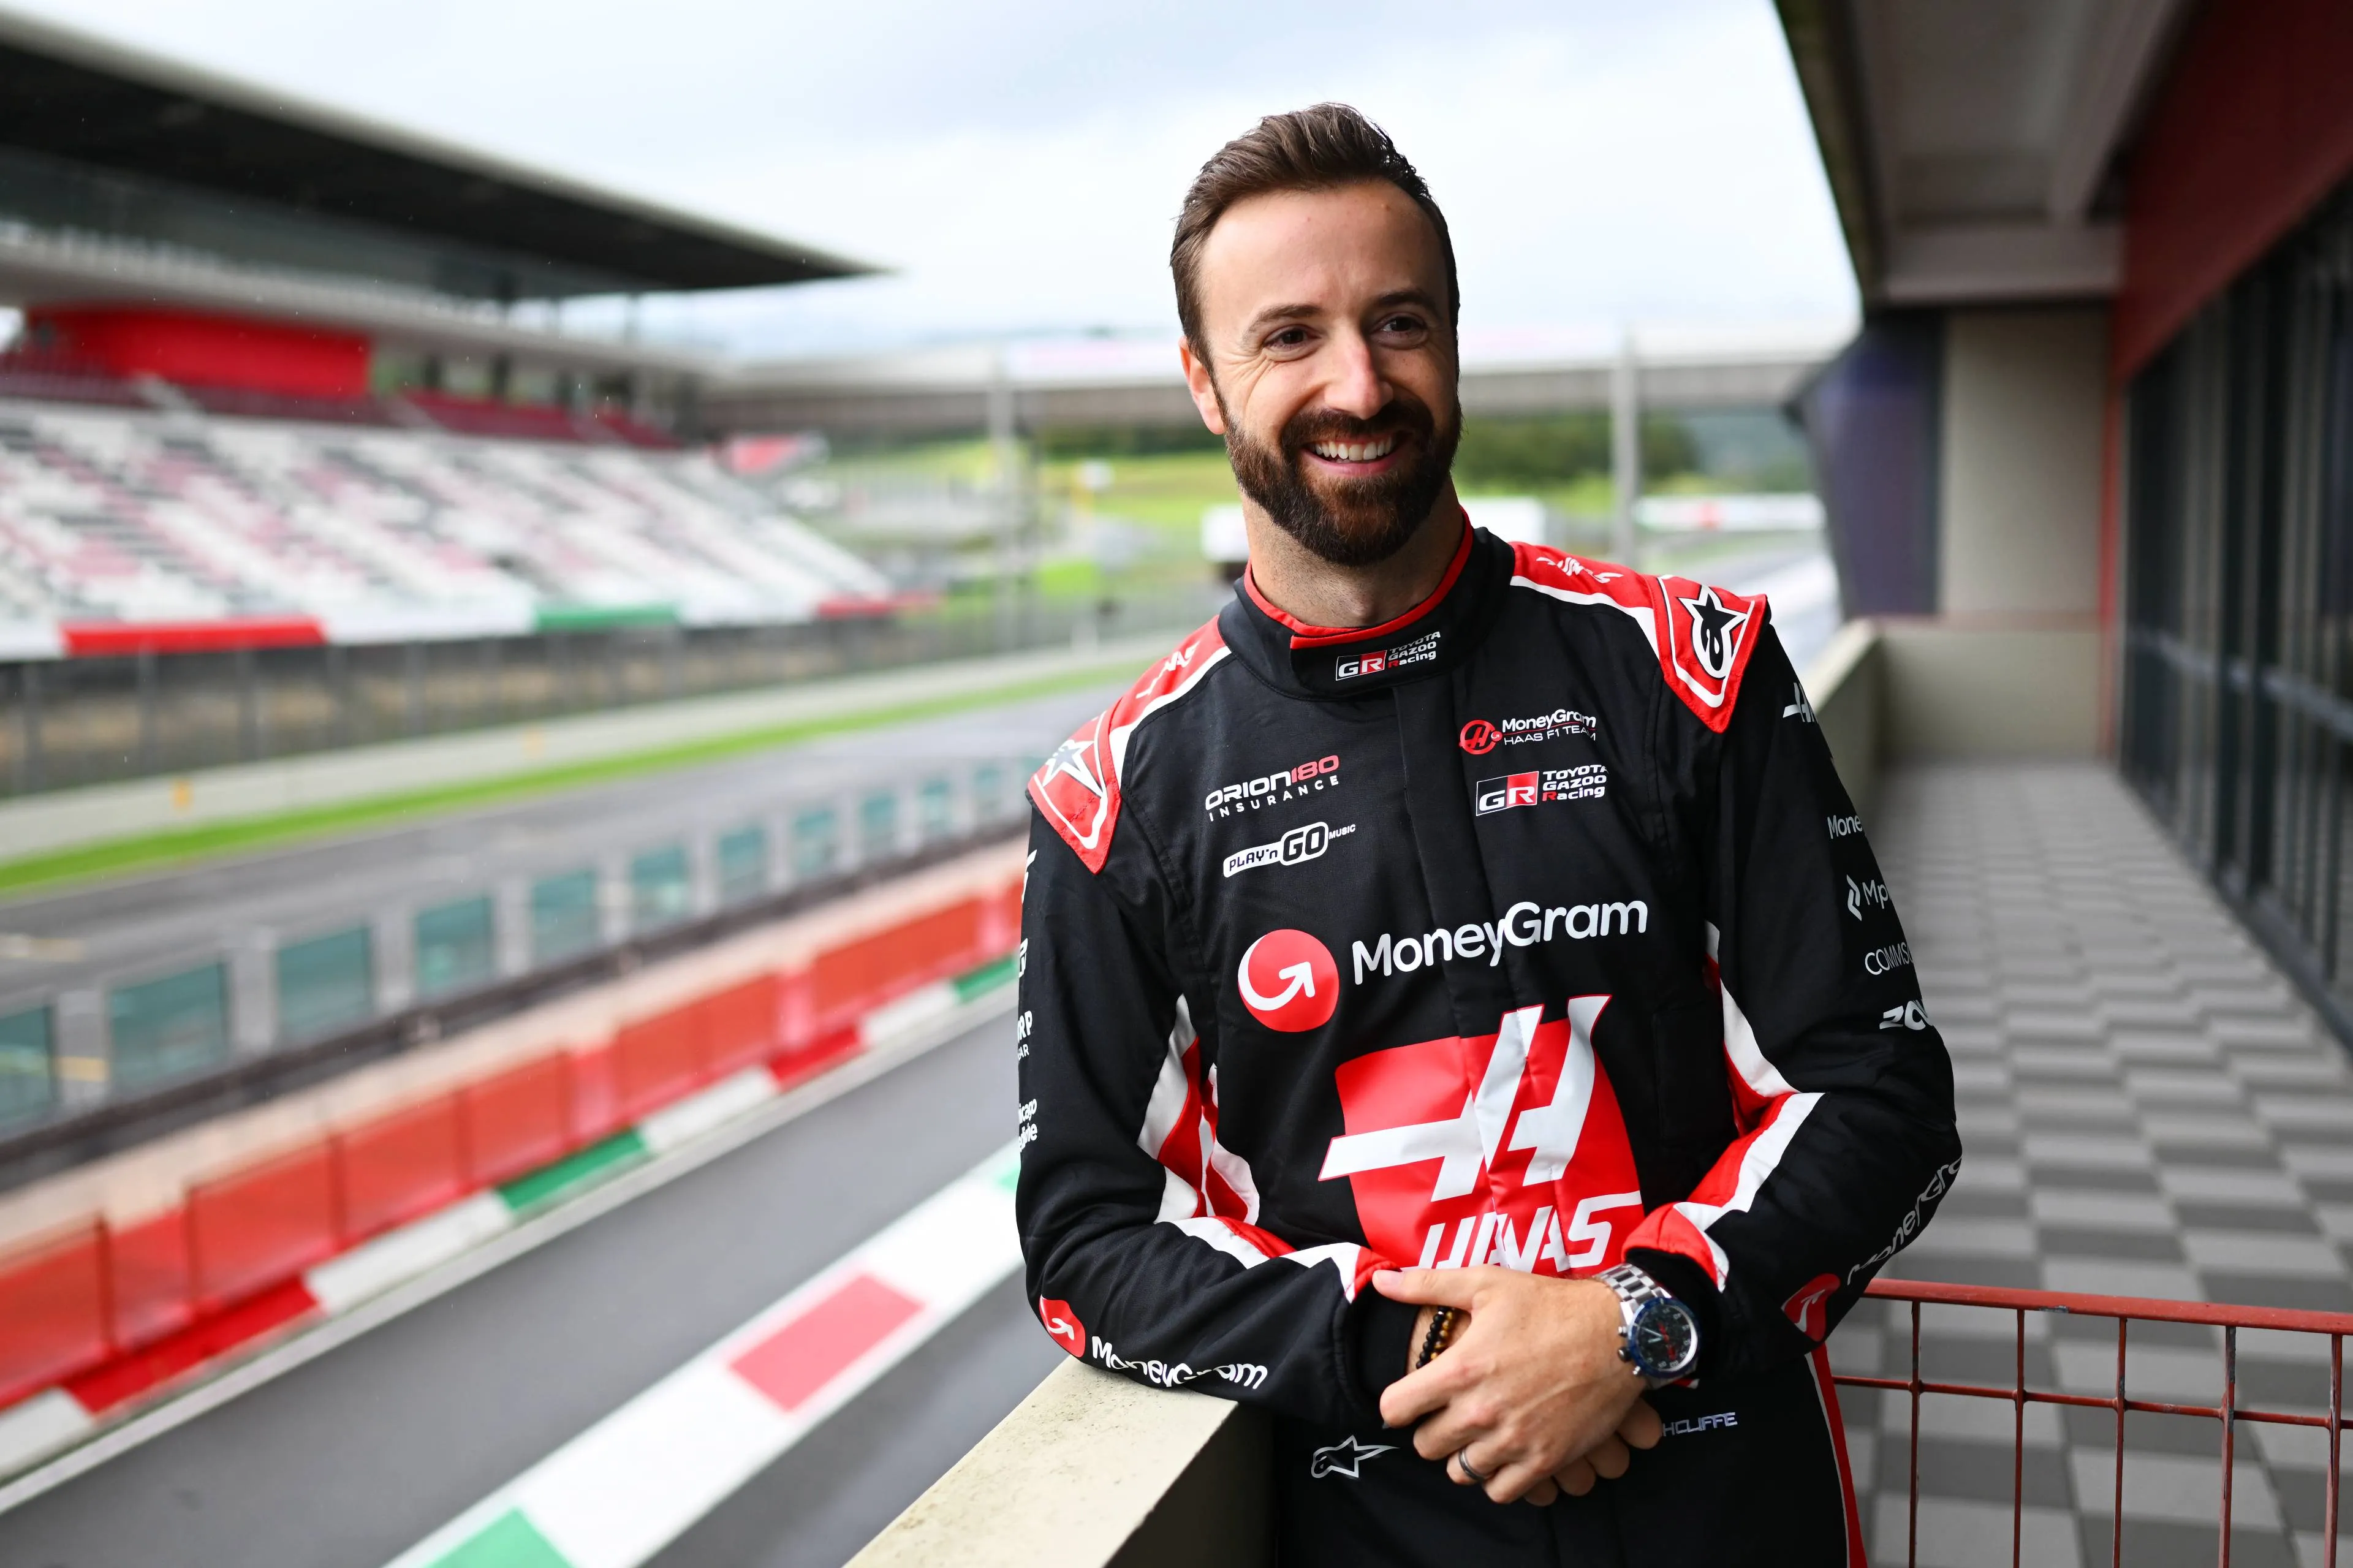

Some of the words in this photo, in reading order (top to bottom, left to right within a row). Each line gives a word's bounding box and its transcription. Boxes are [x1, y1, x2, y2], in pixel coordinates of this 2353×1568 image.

[1388, 641, 1436, 661] GAZOO
[1390, 631, 1441, 653] TOYOTA
[1338, 658, 1382, 677] GR
[1388, 651, 1436, 668] Racing
[1502, 709, 1596, 732] MoneyGram
[1504, 733, 1543, 745] HAAS
[1547, 727, 1559, 739] F1
[1542, 775, 1607, 790] GAZOO
[1543, 764, 1609, 781] TOYOTA
[1209, 775, 1339, 822] INSURANCE
[1479, 786, 1534, 811] GR
[1542, 786, 1605, 801] Racing
[1827, 815, 1863, 839] Mone
[1283, 826, 1325, 862] GO
[1328, 824, 1355, 840] MUSIC
[1862, 879, 1892, 909] Mp
[1352, 900, 1648, 985] MoneyGram
[1865, 942, 1913, 975] COMMS
[1663, 1412, 1738, 1437] HCLIFFE
